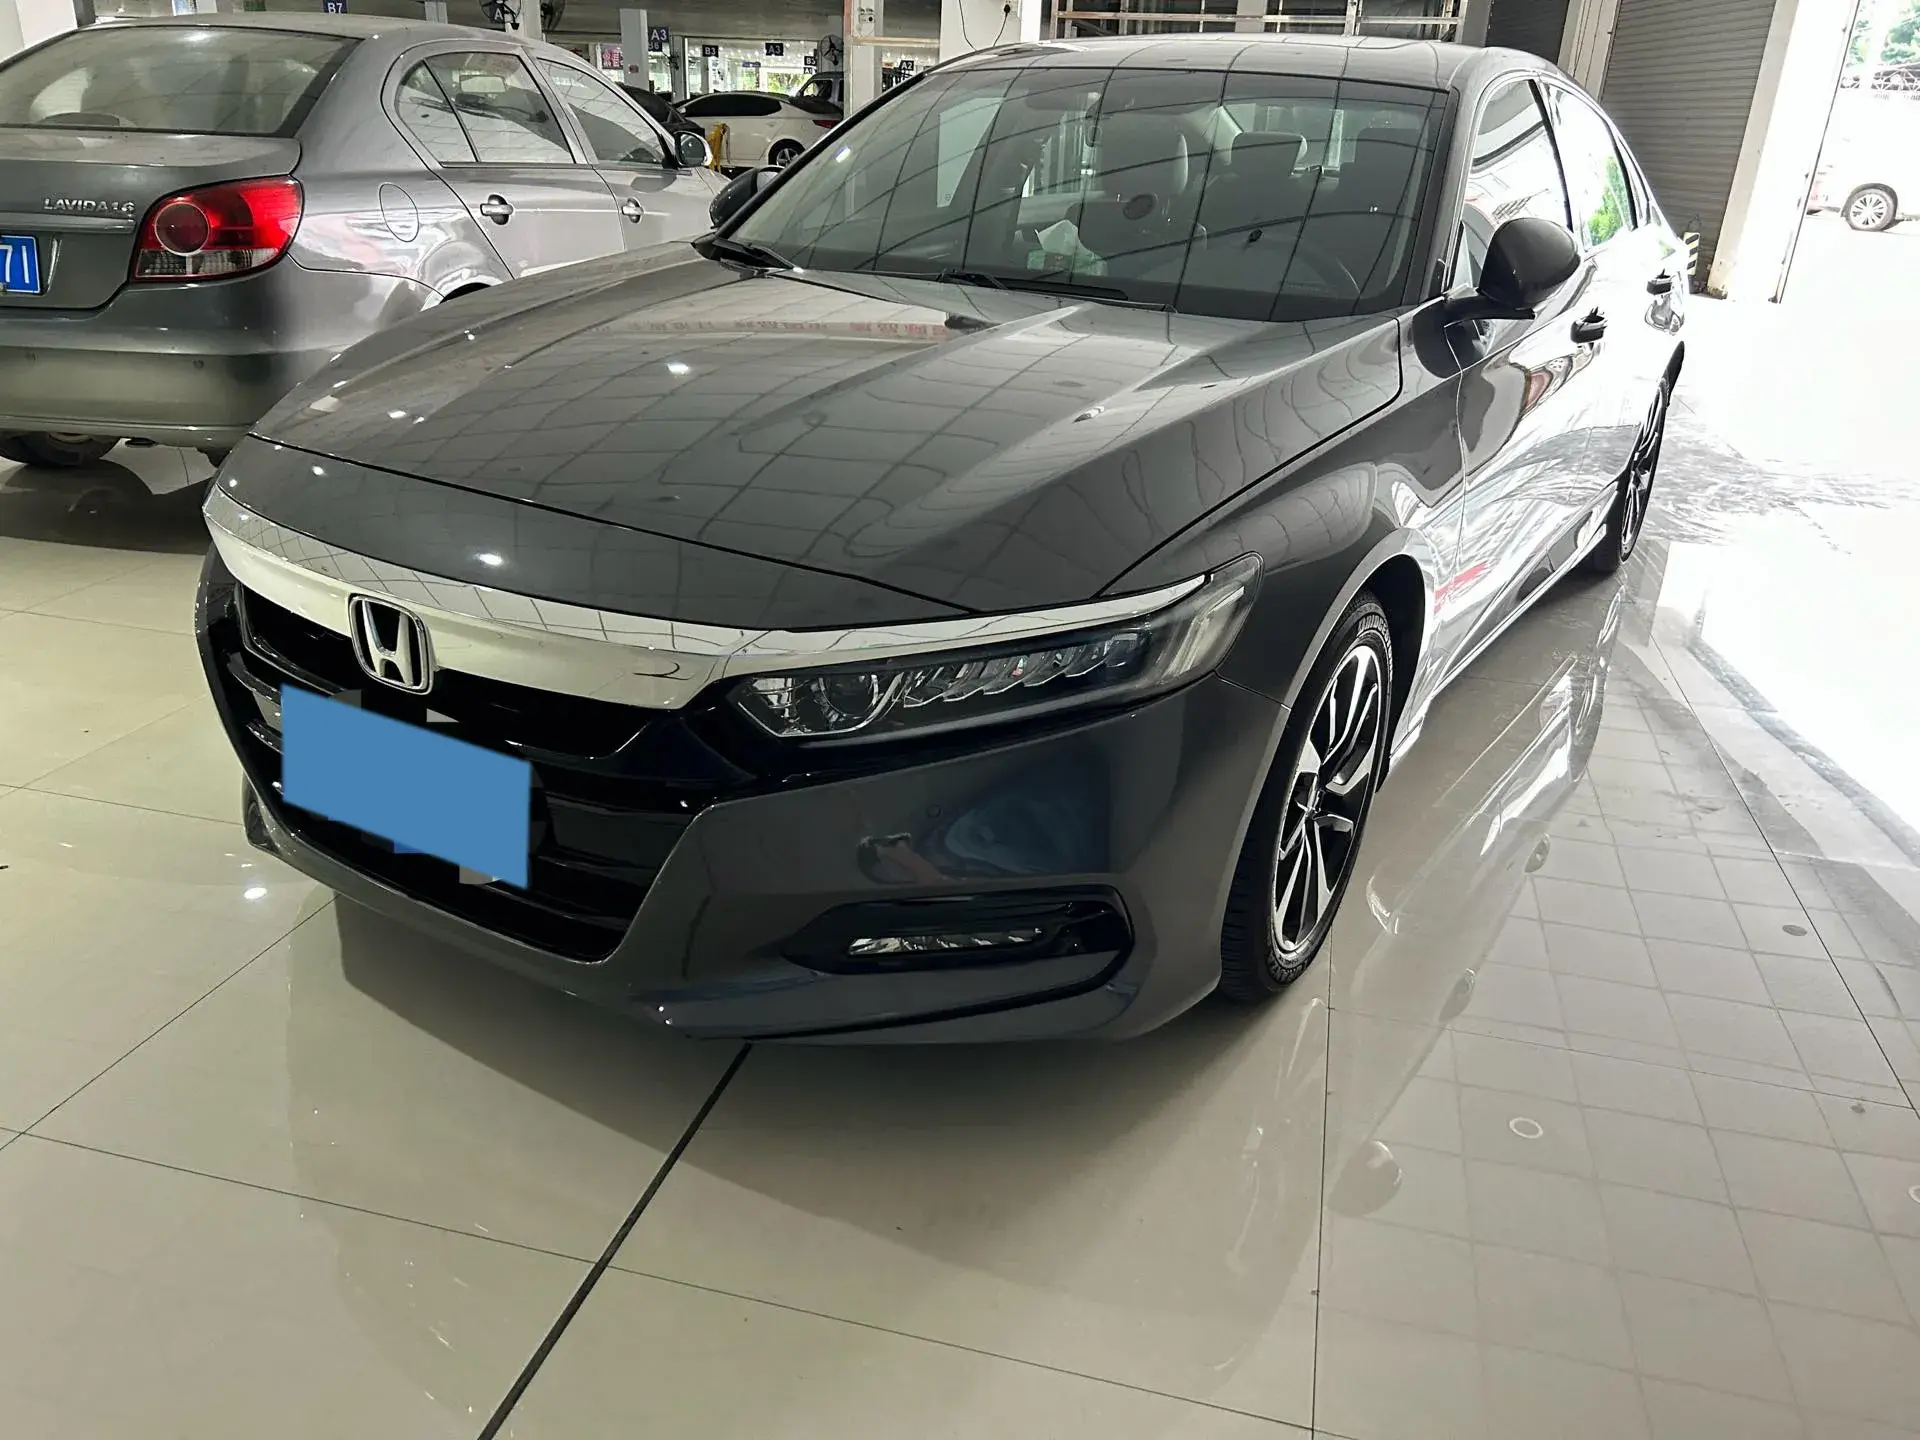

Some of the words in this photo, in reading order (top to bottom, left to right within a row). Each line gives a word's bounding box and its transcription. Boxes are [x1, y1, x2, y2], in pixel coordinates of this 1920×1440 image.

[328, 2, 343, 14] B7
[651, 29, 667, 41] A3
[705, 47, 716, 55] B3
[768, 44, 781, 54] A3
[901, 62, 913, 70] A2
[44, 197, 108, 211] LAVIDA
